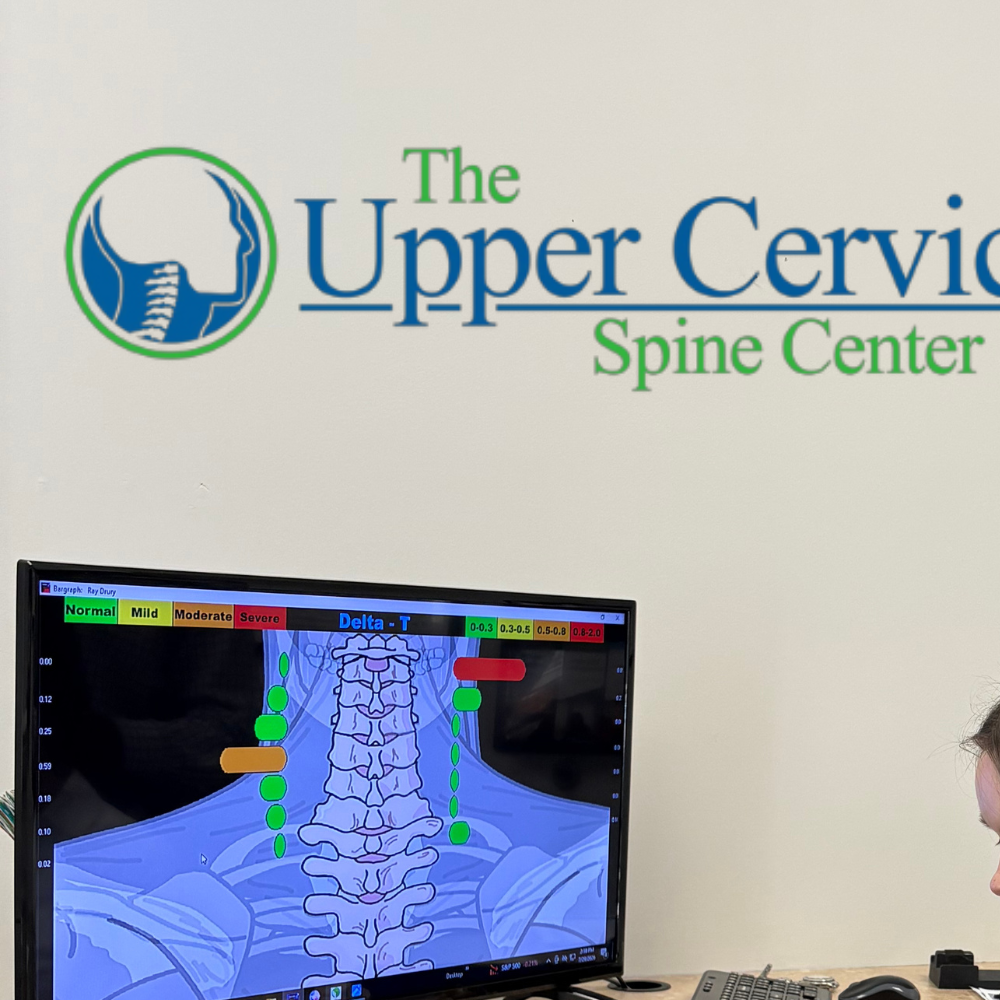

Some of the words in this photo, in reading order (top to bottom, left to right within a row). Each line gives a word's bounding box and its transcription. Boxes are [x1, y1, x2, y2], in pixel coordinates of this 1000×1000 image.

[87, 587, 98, 595] Ray
[99, 587, 117, 597] Drury
[65, 604, 116, 617] Normal
[131, 607, 159, 618] Mild
[174, 609, 233, 621] Moderate
[240, 612, 280, 623] Severe
[339, 612, 384, 630] Delta
[400, 616, 411, 631] T
[470, 622, 493, 632] 0-0.3
[500, 624, 531, 634] 0.3-0.5
[537, 626, 567, 636] 0.5-0.8
[573, 628, 600, 637] 0.8-2.0
[39, 695, 53, 703] 0.12
